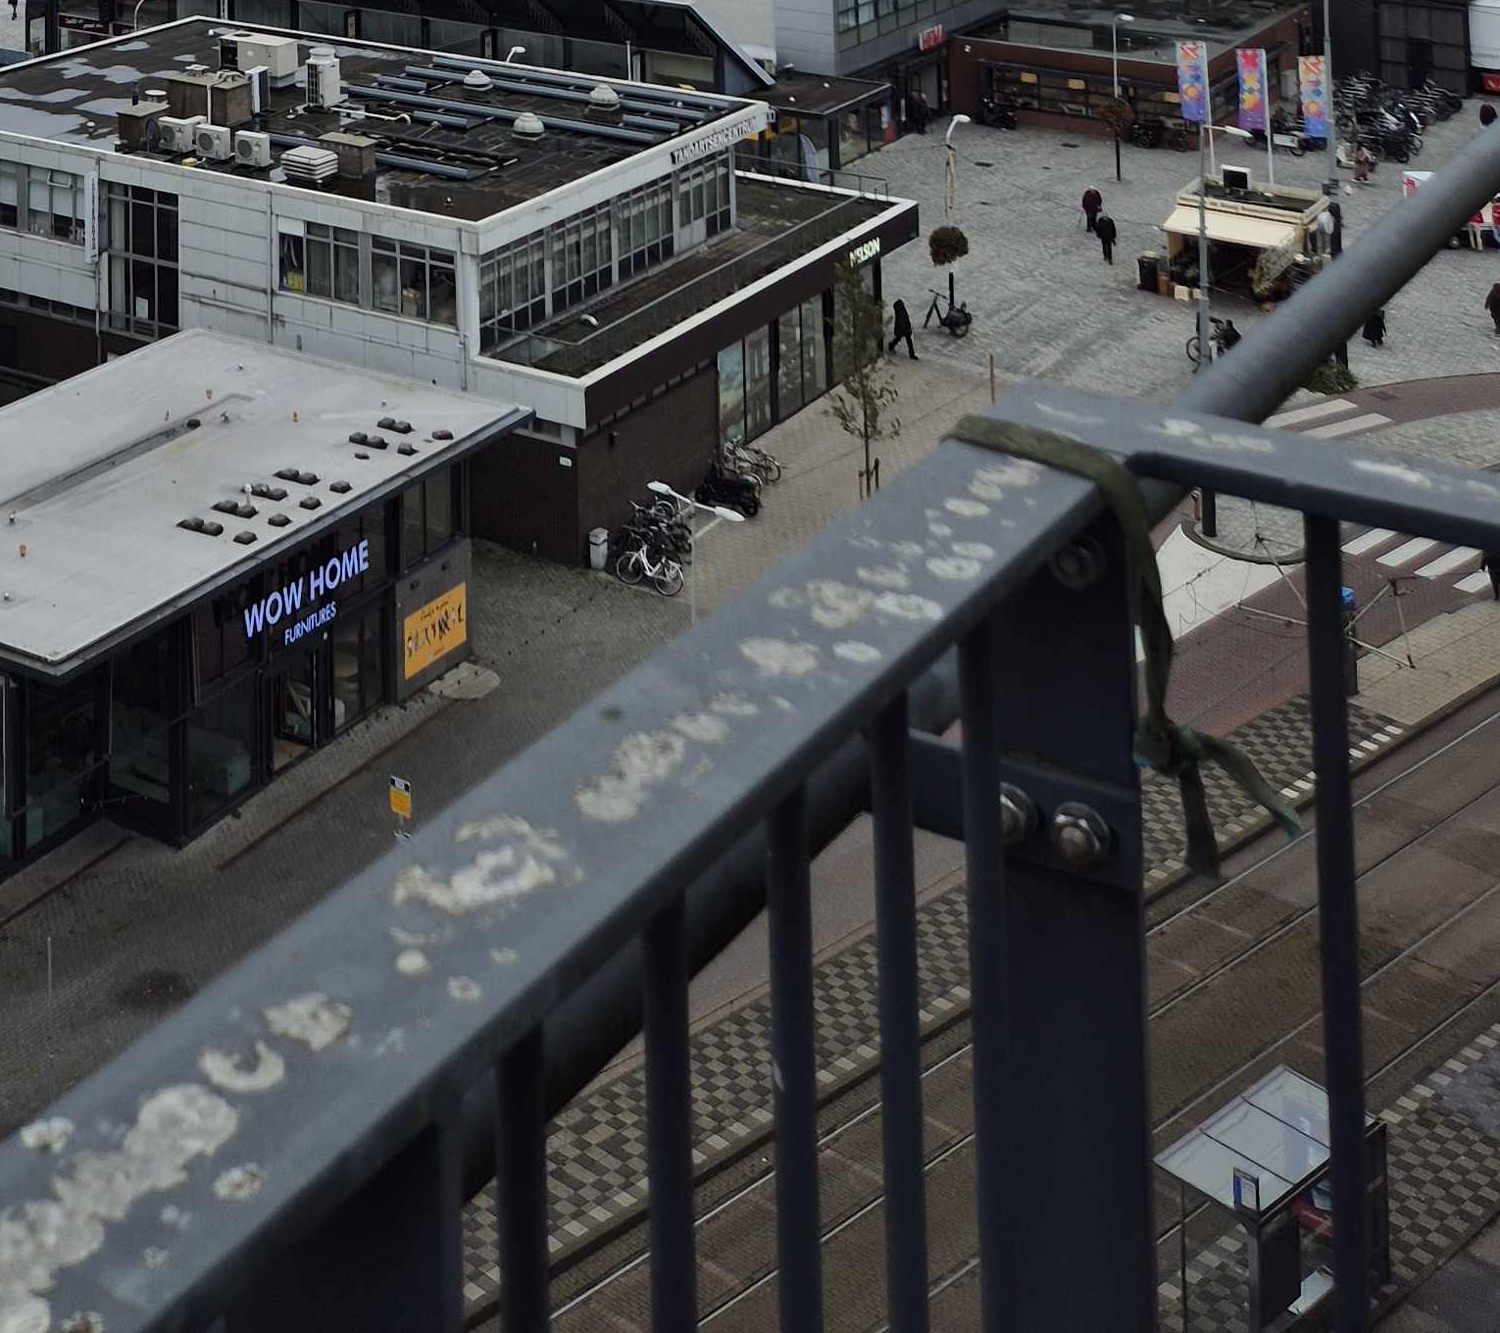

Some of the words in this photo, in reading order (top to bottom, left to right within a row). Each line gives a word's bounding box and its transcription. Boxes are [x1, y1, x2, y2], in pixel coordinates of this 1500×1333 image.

[244, 577, 303, 638] WOW
[310, 539, 369, 602] HOME
[284, 601, 337, 646] FURNITURES
